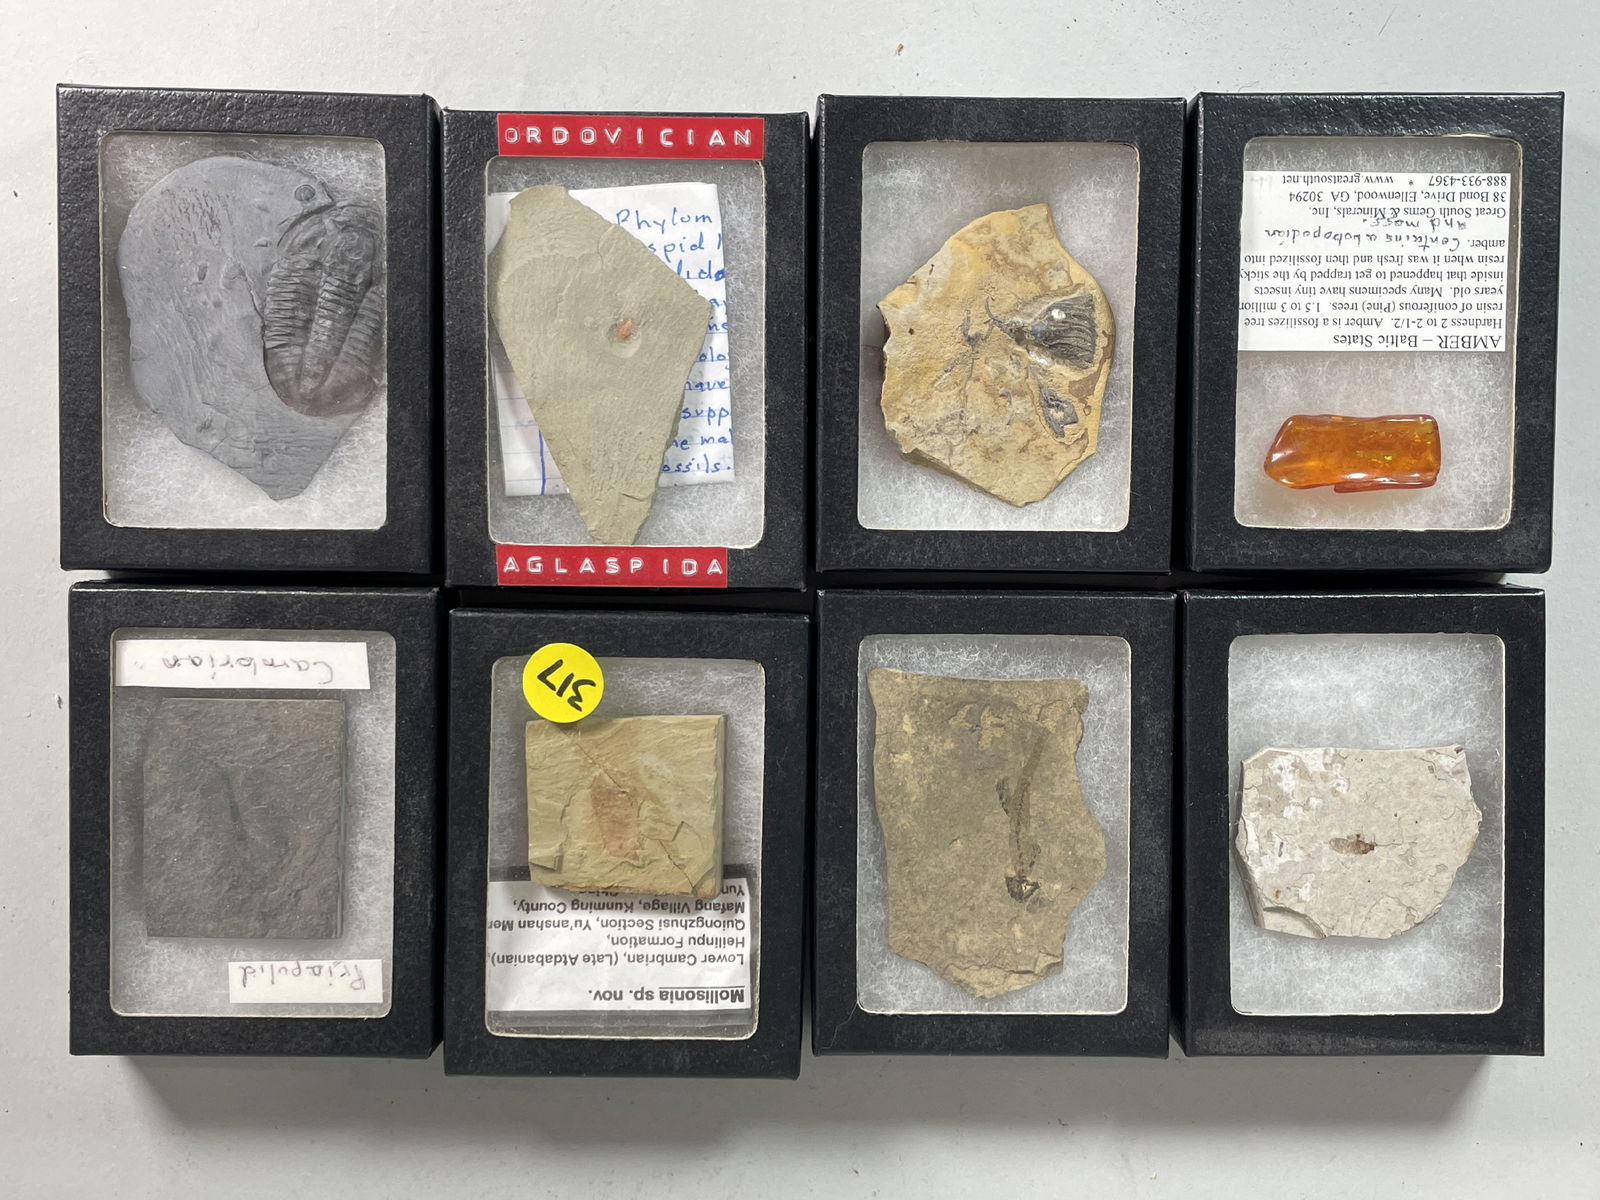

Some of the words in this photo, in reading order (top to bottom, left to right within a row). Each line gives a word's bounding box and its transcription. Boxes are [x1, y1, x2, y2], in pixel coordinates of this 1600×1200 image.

[504, 127, 751, 147] ORDOVICIAN
[1283, 173, 1393, 186] www.greatsouth.net
[1429, 176, 1506, 186] 888-933-4367
[1289, 191, 1323, 201] 30294
[1331, 191, 1349, 201] GA
[1354, 190, 1417, 202] Ellenwood,
[1421, 190, 1455, 202] Drive,
[1459, 191, 1489, 202] Bond
[1494, 191, 1506, 202] 38
[1309, 207, 1328, 218] Inc.
[1333, 205, 1385, 218] Minerals,
[1390, 207, 1400, 218] &
[1404, 207, 1435, 218] Gems
[1440, 207, 1472, 218] South
[1476, 207, 1506, 218] Great
[1467, 239, 1505, 249] amber.
[1245, 255, 1265, 266] into
[1269, 254, 1322, 266] fossilized
[1326, 255, 1349, 266] then
[1353, 255, 1373, 266] and
[1376, 255, 1404, 266] fresh
[1408, 255, 1428, 264] was
[1433, 255, 1440, 266] it
[1444, 255, 1473, 266] when
[1477, 255, 1504, 266] resin
[1273, 271, 1289, 282] the
[1293, 268, 1306, 282] by
[1310, 268, 1351, 282] trapped
[1356, 268, 1371, 280] get
[1376, 271, 1386, 280] to
[1390, 269, 1443, 282] happened
[1447, 271, 1467, 282] that
[1471, 271, 1503, 282] inside
[1254, 287, 1291, 297] insects
[1296, 284, 1316, 297] tiny
[1320, 287, 1346, 297] have
[1349, 284, 1406, 297] specimens
[1411, 285, 1442, 297] Many
[1450, 287, 1471, 297] old.
[1474, 285, 1503, 296] years
[1281, 302, 1287, 312] 3
[1291, 302, 1301, 312] to
[1305, 302, 1321, 313] 1.5
[1329, 302, 1358, 312] trees.
[1362, 301, 1395, 313] (Pine)
[1399, 302, 1457, 313] coniferous
[1459, 303, 1472, 313] of
[1476, 303, 1502, 313] resin
[1244, 317, 1264, 327] tree
[1268, 317, 1319, 328] fossilizes
[1322, 317, 1329, 326] a
[1332, 317, 1341, 328] is
[1346, 317, 1383, 328] Amber
[1390, 317, 1423, 328] 2-1/2.
[1427, 318, 1437, 327] to
[1441, 318, 1448, 328] 2
[1451, 318, 1502, 328] Hardness
[1333, 335, 1373, 348] States
[1378, 335, 1418, 348] Baltic
[1437, 335, 1501, 349] AMBER
[503, 556, 723, 575] AGLASPIDA
[537, 659, 596, 712] 317
[513, 900, 566, 914] County,
[571, 899, 634, 914] Kunming
[639, 899, 690, 914] Village,
[695, 899, 745, 914] Mafang
[596, 917, 654, 930] Section,
[658, 917, 745, 931] Quiongzhusi
[607, 934, 683, 948] Formation,
[688, 934, 744, 948] Heilinpu
[583, 952, 618, 965] (Late
[623, 952, 697, 965] Cambrian,
[701, 953, 743, 965] Lower
[588, 990, 623, 1002] nov.
[629, 987, 654, 1001] sp.
[659, 989, 744, 1004] Mollisonia
